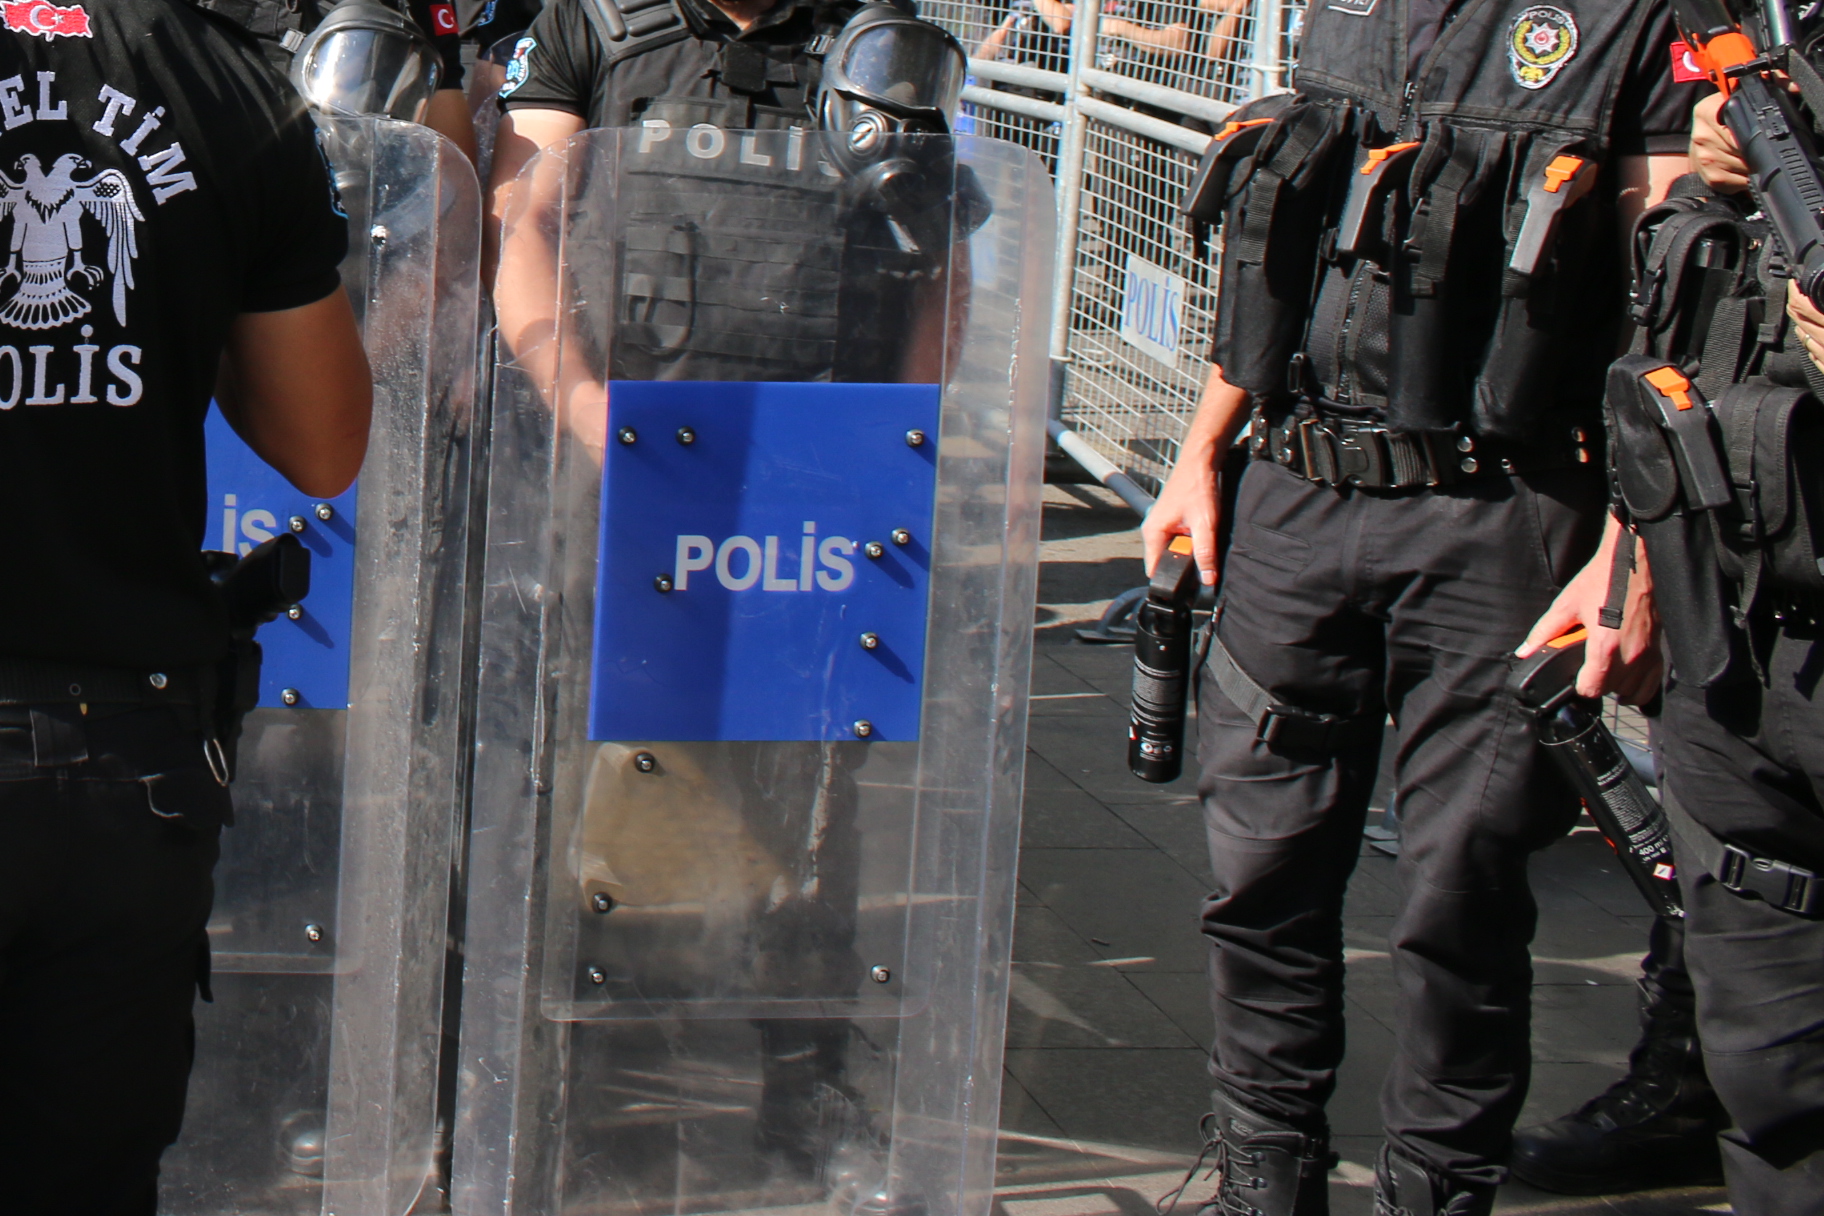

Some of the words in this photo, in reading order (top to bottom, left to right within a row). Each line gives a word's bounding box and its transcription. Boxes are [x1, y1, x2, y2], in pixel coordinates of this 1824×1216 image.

[91, 83, 198, 206] TİM
[1127, 267, 1179, 356] POLİS
[673, 520, 855, 593] POLİS
